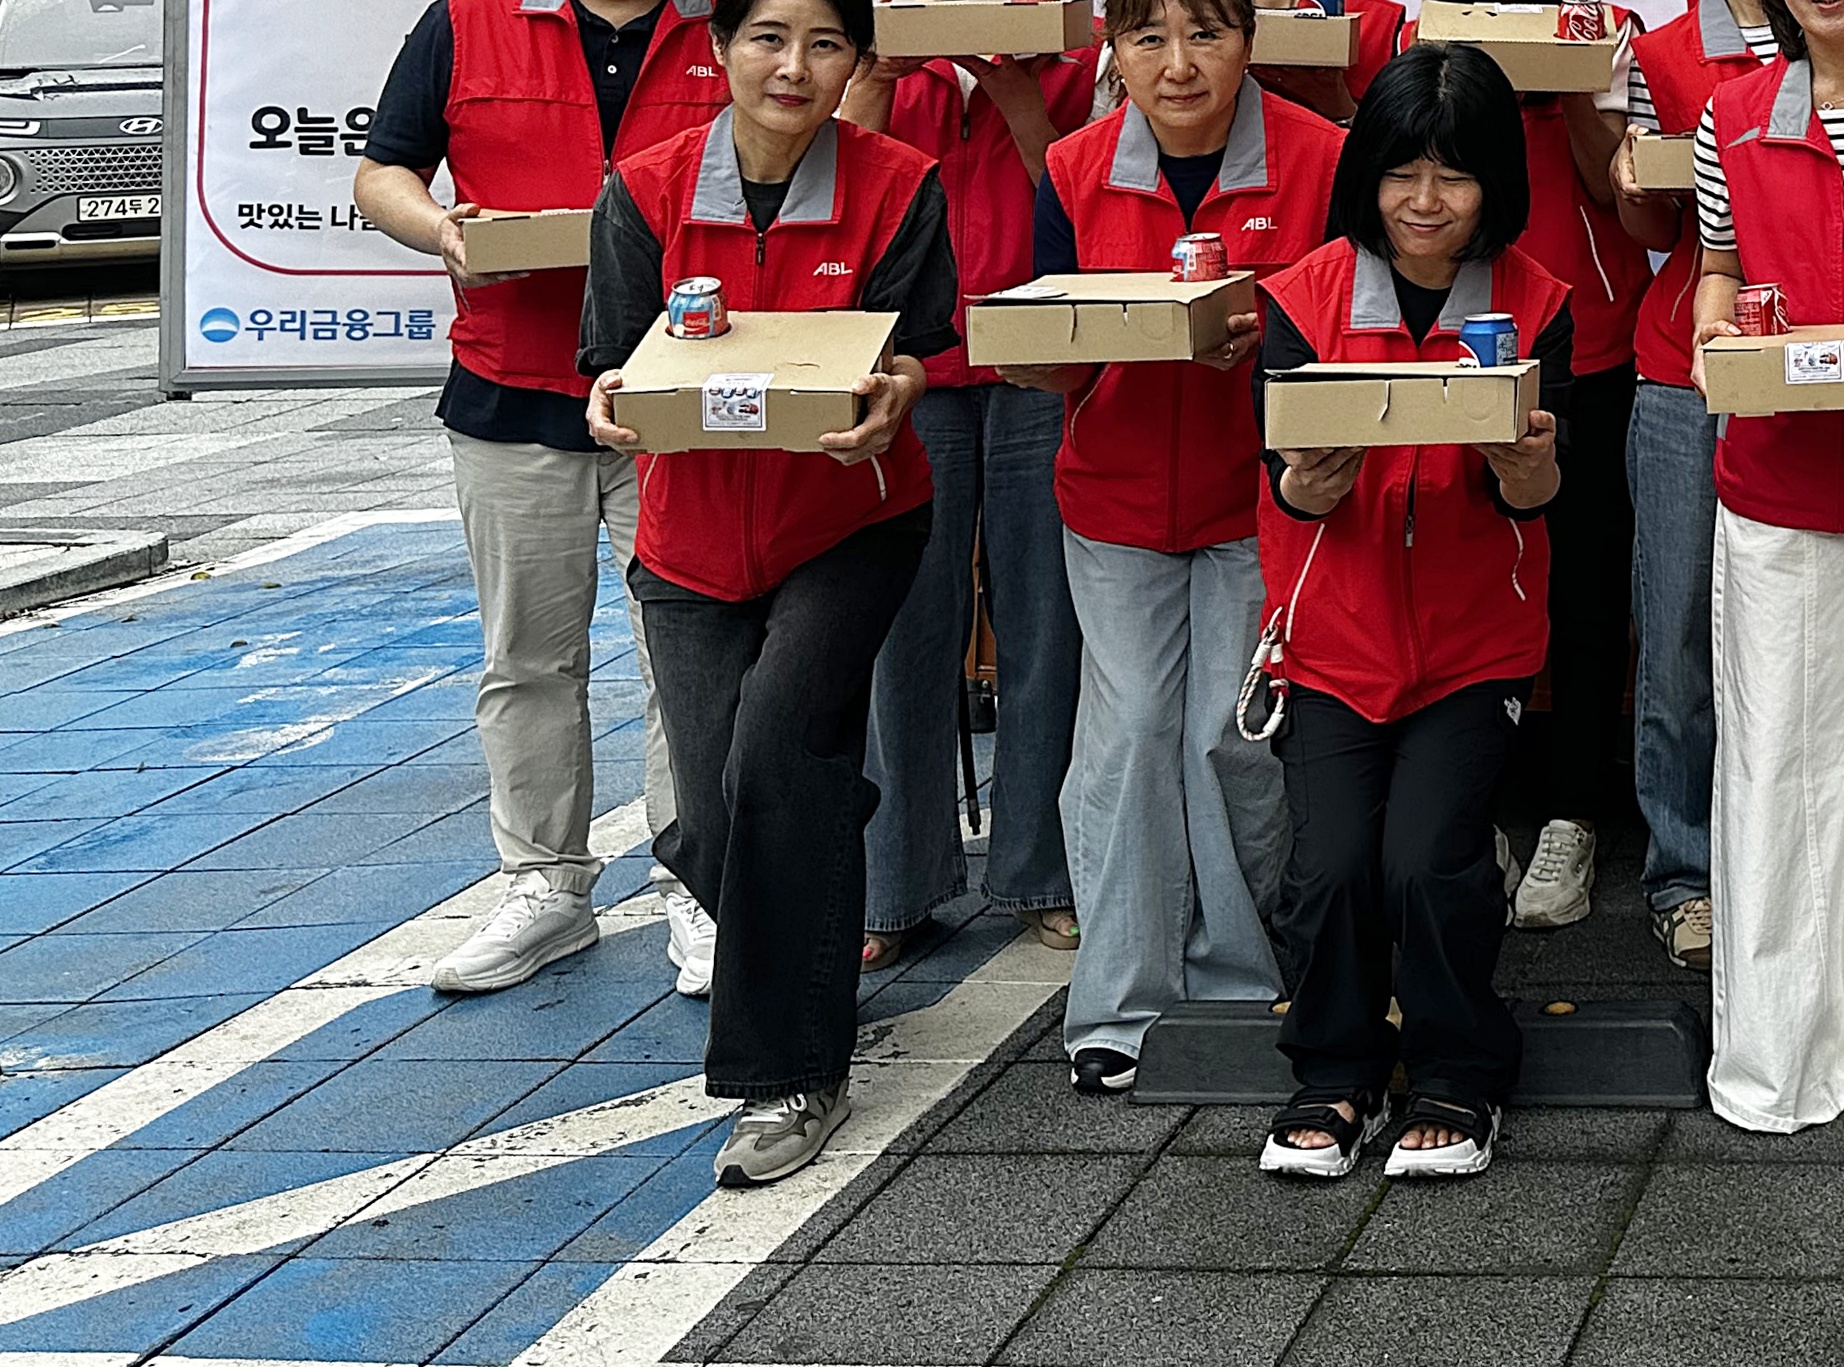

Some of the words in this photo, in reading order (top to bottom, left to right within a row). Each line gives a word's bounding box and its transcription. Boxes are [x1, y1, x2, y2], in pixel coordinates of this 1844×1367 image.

[685, 65, 719, 78] ABL
[87, 198, 143, 218] 274두
[237, 203, 323, 231] 맛있는
[1241, 217, 1278, 231] ABL
[813, 262, 853, 276] ABL
[244, 306, 434, 343] 우리금융그룹
